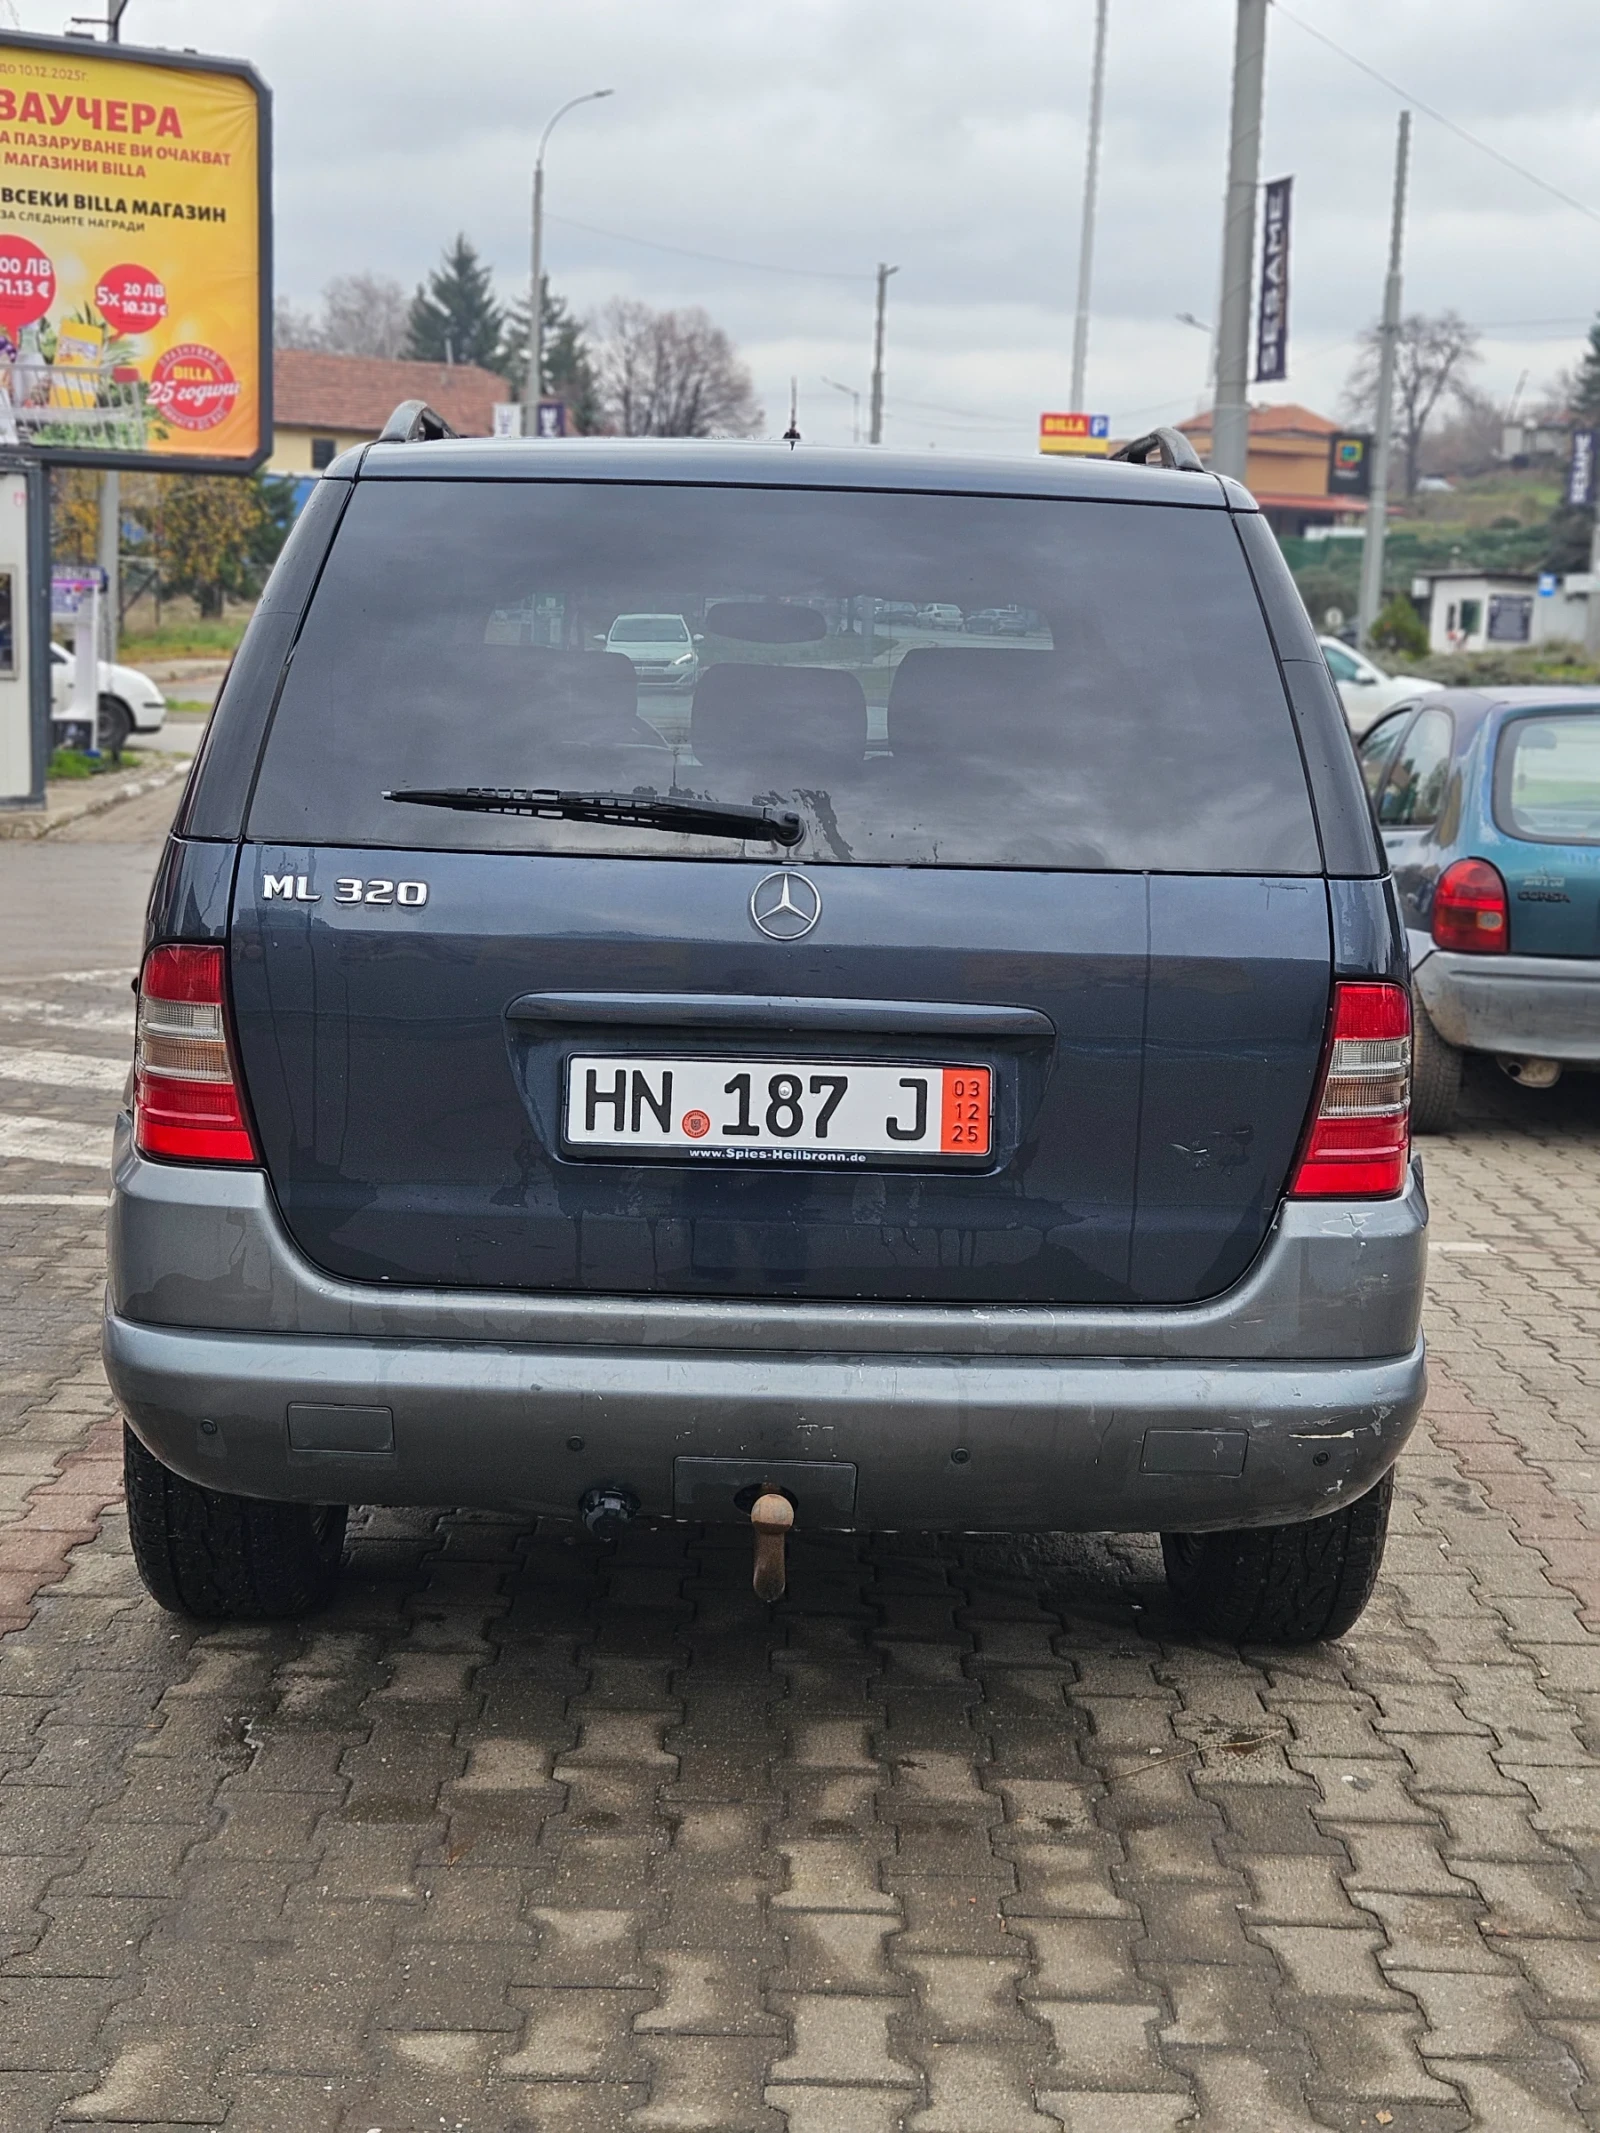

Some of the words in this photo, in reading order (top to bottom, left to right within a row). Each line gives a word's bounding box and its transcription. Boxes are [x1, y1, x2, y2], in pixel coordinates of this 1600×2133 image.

[0, 88, 183, 139] ВАУЧЕРА
[14, 131, 127, 156] ПАЗАРУВАНЕ
[130, 143, 153, 158] ВИ
[156, 146, 231, 166] ОЧАКВАТ
[4, 151, 98, 174] МАГАЗИНИ
[102, 161, 146, 178] BILLA
[1, 187, 69, 209] ВСЕКИ
[74, 193, 128, 214] BILLA
[132, 199, 227, 223] МАГАЗИН
[19, 211, 85, 227] СЛЕДНИТЕ
[88, 217, 145, 233] НАГРАДИ
[24, 257, 51, 277] ЛВ
[123, 282, 141, 297] 20
[173, 365, 213, 382] BILLA
[146, 381, 176, 405] 25
[1044, 417, 1085, 433] BILLA
[262, 874, 322, 900] ML
[333, 878, 429, 906] 320
[954, 1080, 980, 1097] 03
[585, 1068, 673, 1133] HN
[722, 1073, 849, 1139] 187
[886, 1077, 928, 1141] J
[956, 1103, 980, 1120] 12
[952, 1125, 979, 1142] 25
[689, 1148, 867, 1162] www.Spies-Heilbronn.de
